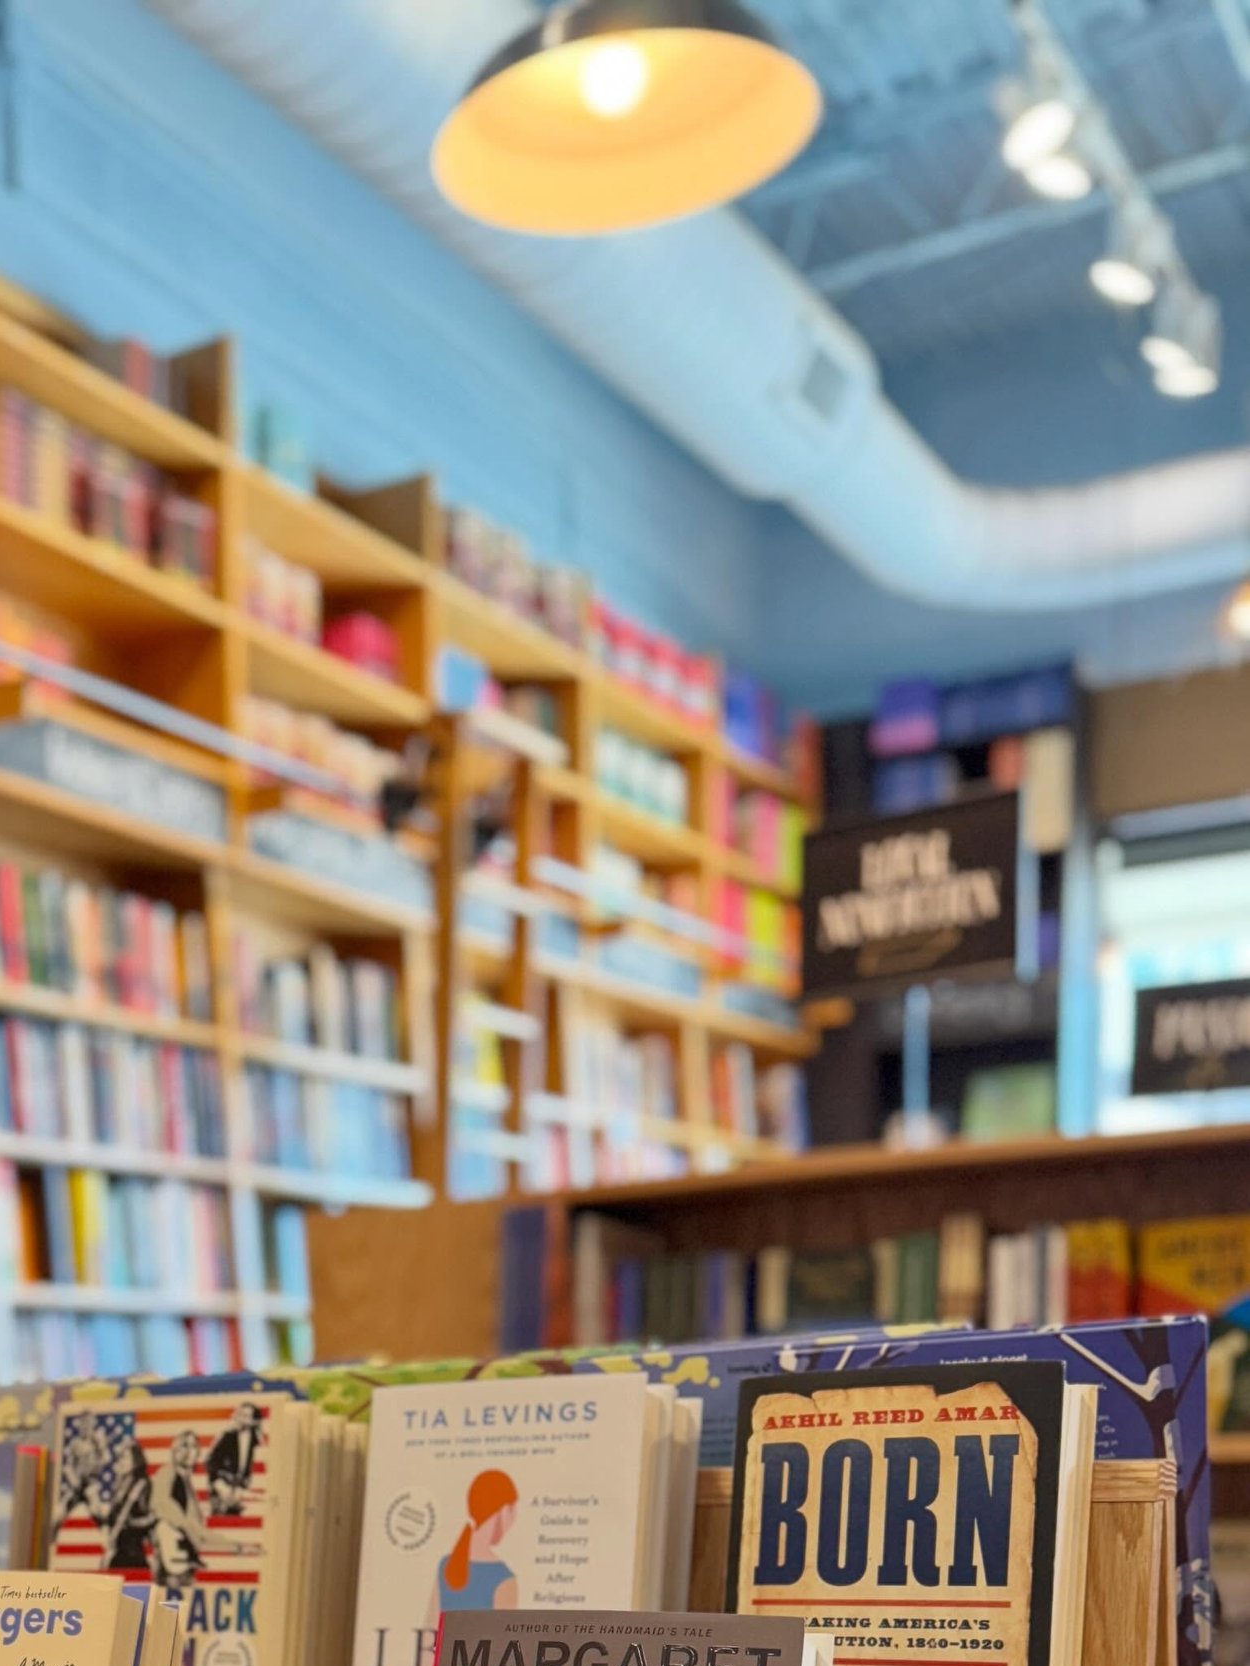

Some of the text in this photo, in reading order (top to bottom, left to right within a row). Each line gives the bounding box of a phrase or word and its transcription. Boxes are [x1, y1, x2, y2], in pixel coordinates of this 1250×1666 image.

[404, 1401, 598, 1430] TIA LEVINGS
[762, 1405, 1021, 1431] AKHIL REED AMAR
[531, 1496, 598, 1507] A Survivor's
[753, 1434, 1020, 1587] BORN
[540, 1516, 588, 1526] Guide to
[538, 1535, 588, 1547] Recovery
[535, 1554, 588, 1568] and Hope
[547, 1573, 574, 1584] After
[1, 1585, 22, 1598] Times
[25, 1586, 67, 1599] bestseller
[533, 1592, 586, 1604] Religious
[504, 1623, 714, 1638] AUTHOR OF THE HANDMAID'S TALE
[806, 1616, 991, 1632] AKING AMERICA'S
